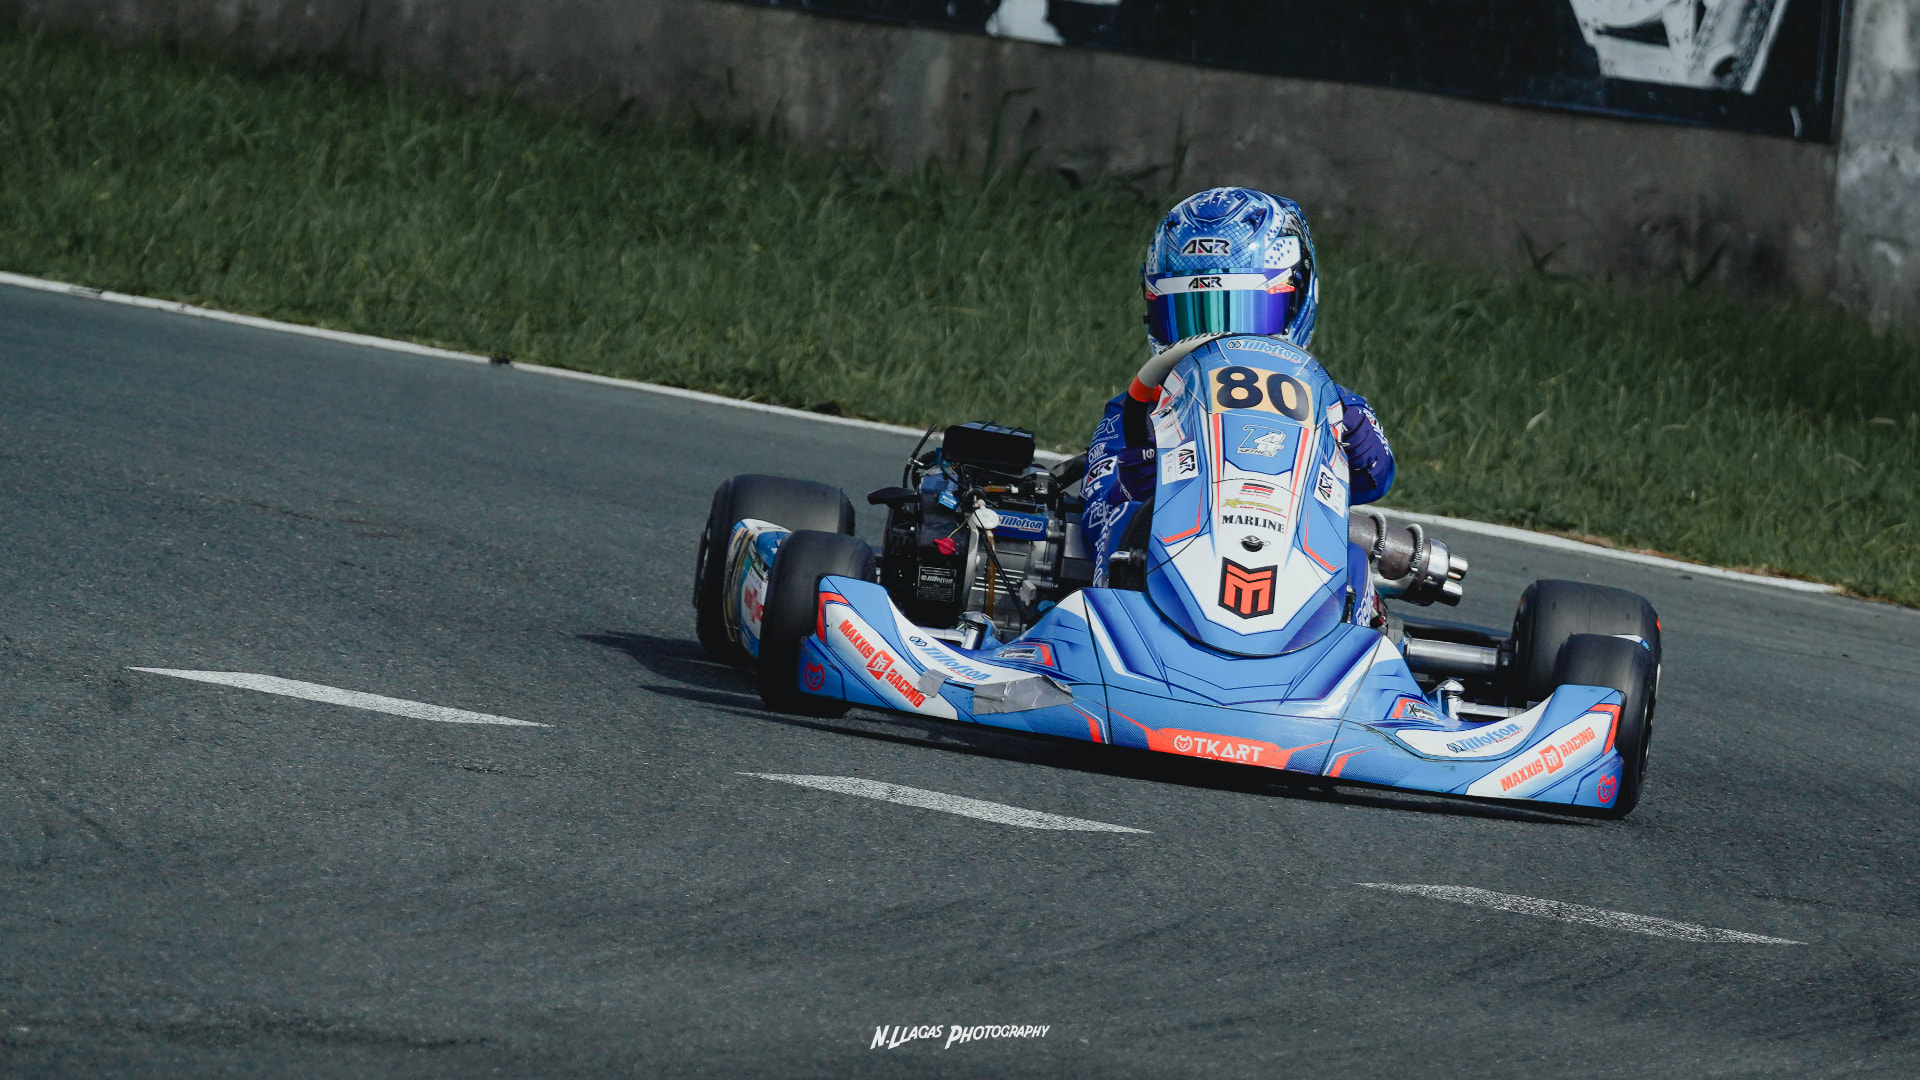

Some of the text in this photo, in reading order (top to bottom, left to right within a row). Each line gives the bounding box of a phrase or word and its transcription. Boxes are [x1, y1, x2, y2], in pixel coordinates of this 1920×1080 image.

[1242, 340, 1302, 362] Tillotson
[1216, 366, 1310, 421] 80
[1000, 514, 1044, 530] Tillotson
[1221, 514, 1285, 533] MARLINE
[838, 619, 876, 660] MAXXIS
[885, 667, 926, 708] RACING
[922, 645, 992, 681] Tillotson
[1194, 737, 1264, 762] TKART
[1457, 722, 1521, 751] Tillotson
[1500, 758, 1544, 791] MAXXIS
[1559, 726, 1596, 757] RACING
